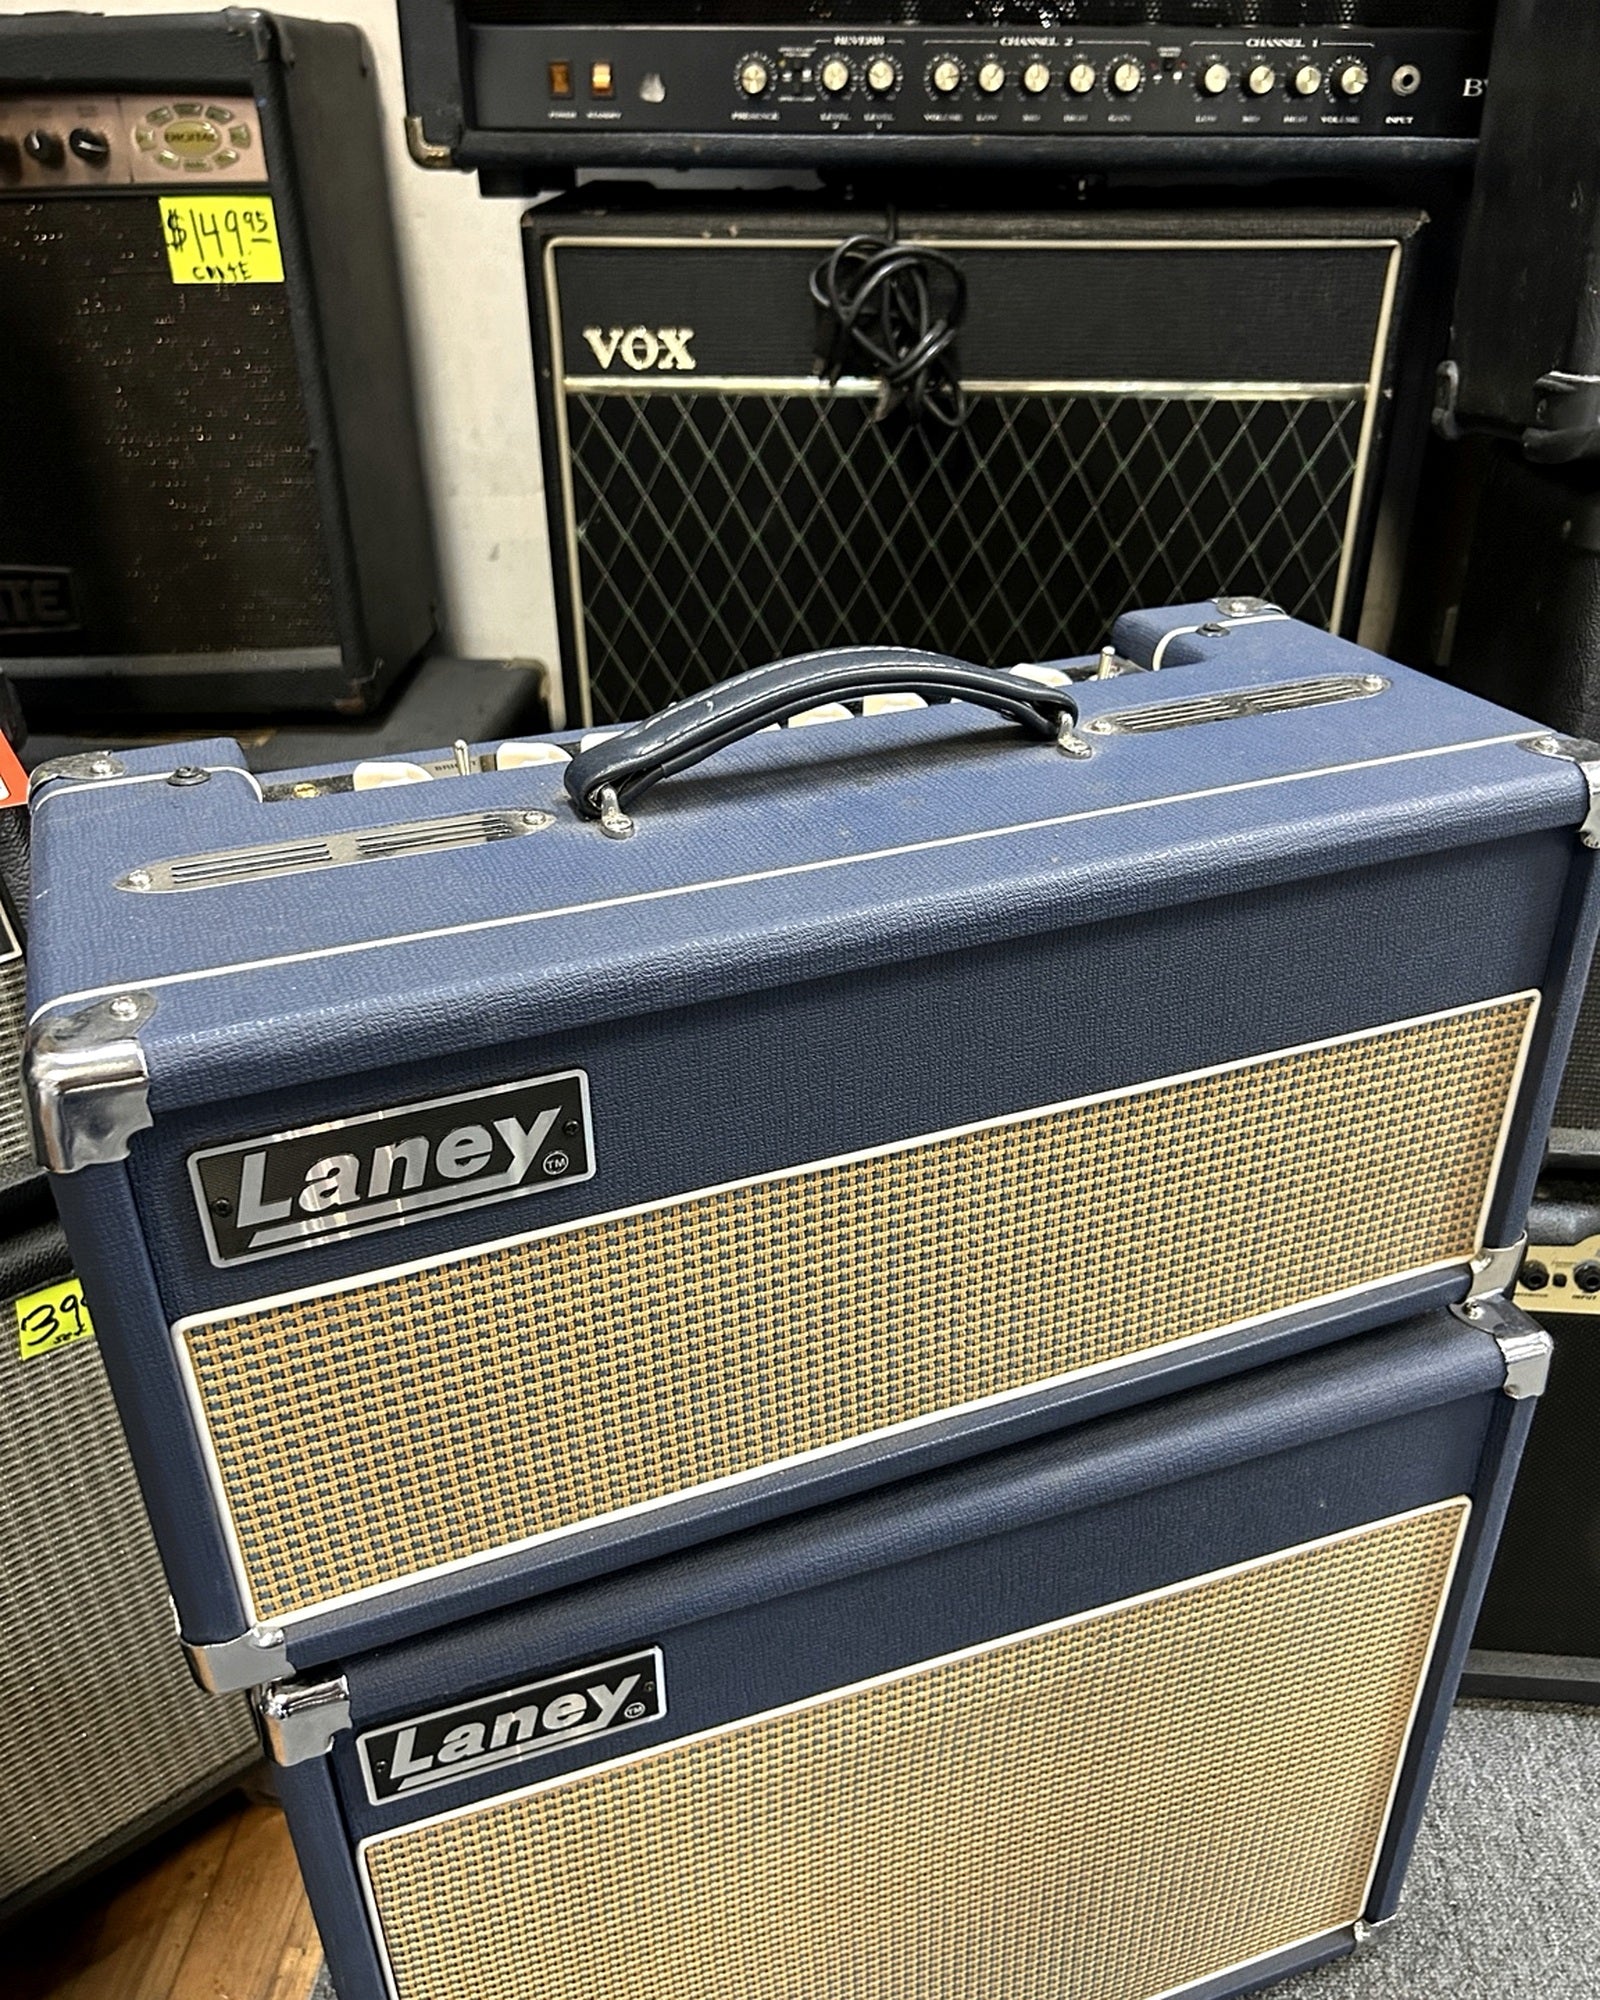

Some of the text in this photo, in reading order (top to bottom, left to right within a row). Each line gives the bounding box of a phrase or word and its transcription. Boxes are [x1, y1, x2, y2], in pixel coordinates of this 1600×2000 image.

[1000, 36, 1074, 47] CHANNEL 2
[1246, 38, 1319, 48] CHANNEL 1
[1462, 77, 1489, 97] B
[582, 325, 697, 371] VOX
[0, 579, 67, 620] TE
[236, 1106, 562, 1247] Laney
[390, 1673, 641, 1790] Laney
